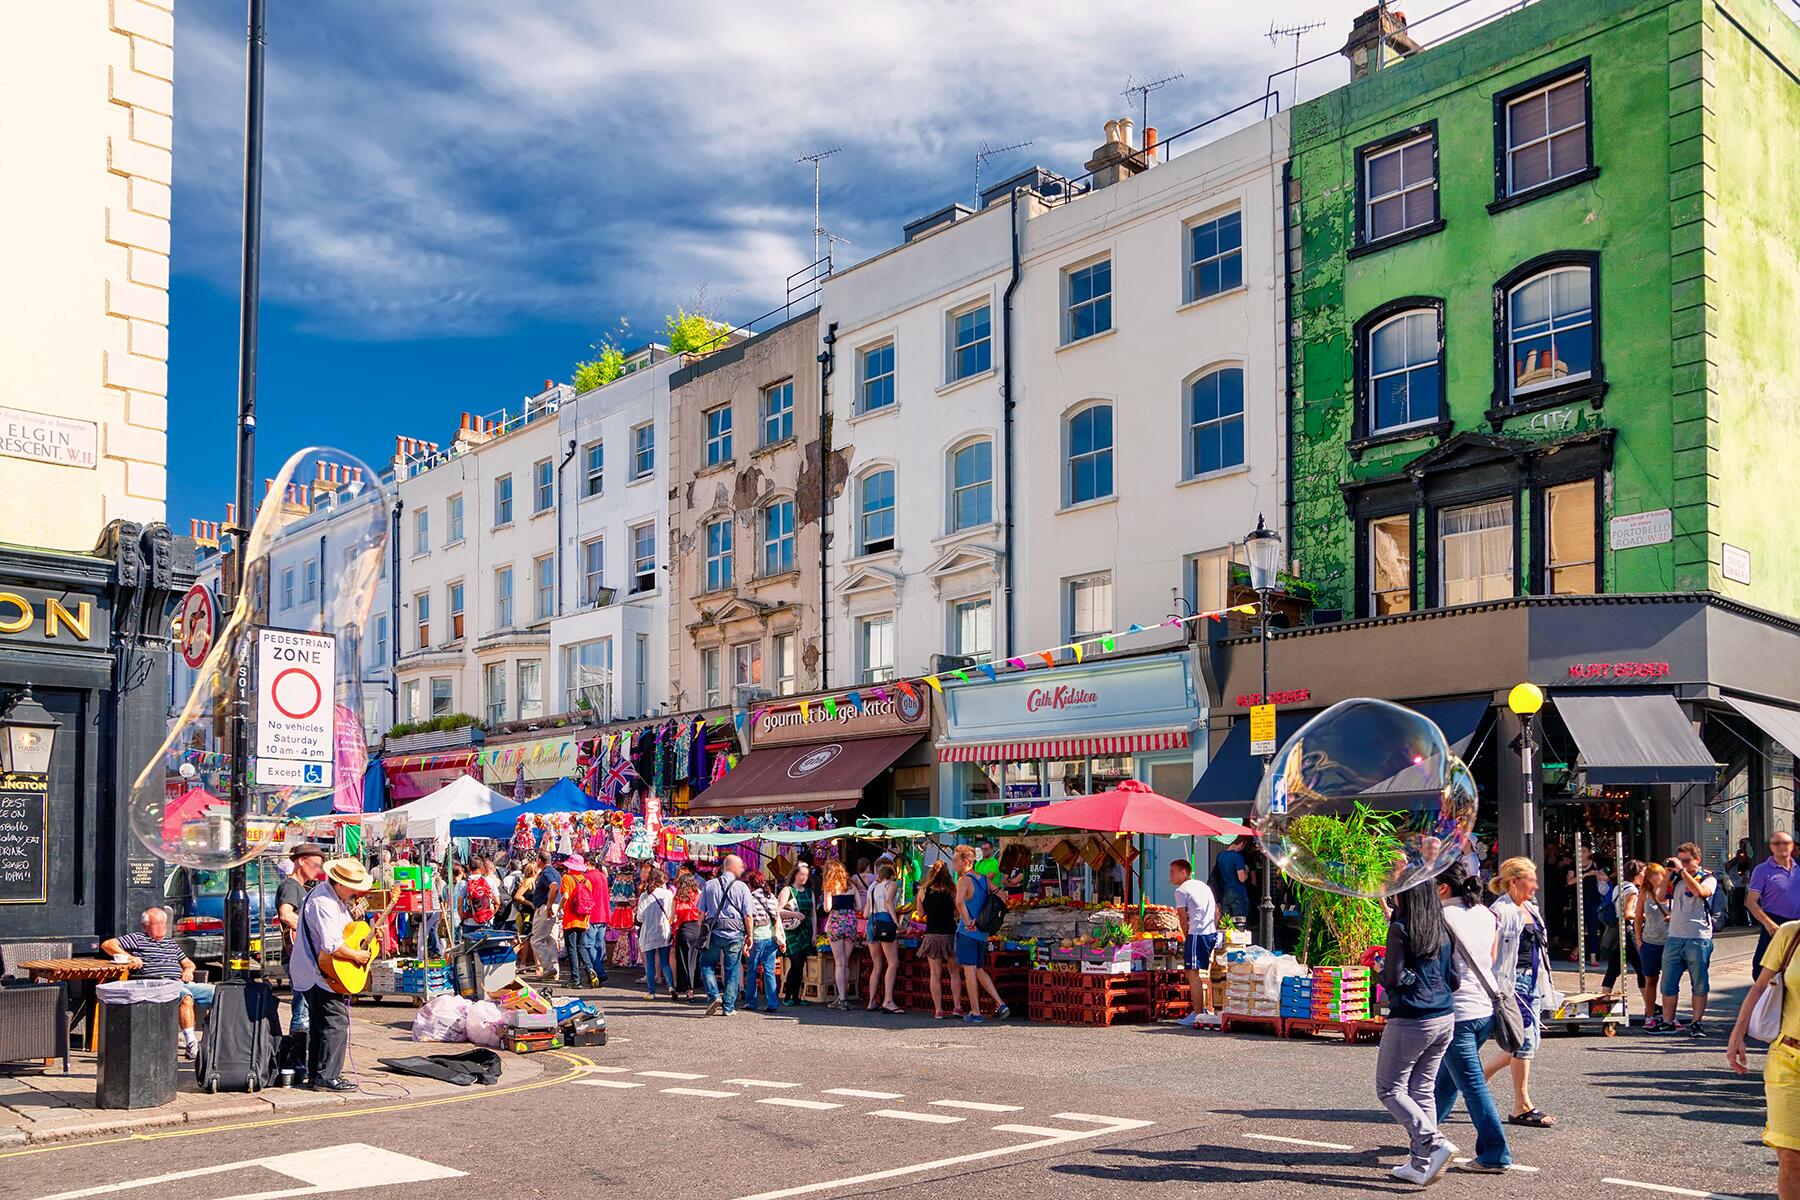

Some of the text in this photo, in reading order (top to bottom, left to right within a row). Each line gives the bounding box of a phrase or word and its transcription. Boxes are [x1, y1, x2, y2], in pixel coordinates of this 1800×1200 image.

[1531, 410, 1573, 429] CITY
[8, 423, 70, 446] ELGIN
[1612, 523, 1670, 540] PORTOBELLO
[0, 592, 91, 641] ON
[263, 633, 331, 649] PEDESTRIAN
[273, 647, 320, 664] ZONE
[1567, 662, 1671, 679] KURT GEIGER
[1026, 685, 1098, 712] Cath Kidston
[268, 720, 282, 730] No
[285, 722, 324, 733] vehicles
[273, 734, 318, 747] Saturday
[266, 745, 277, 754] 10
[280, 747, 293, 755] am
[301, 747, 308, 755] 4
[310, 749, 324, 757] pm
[267, 767, 301, 778] Except
[10, 809, 26, 819] ON
[744, 807, 762, 815] gourmet
[763, 806, 777, 814] burger
[247, 829, 286, 842] GERMAN
[1029, 864, 1045, 873] BAG
